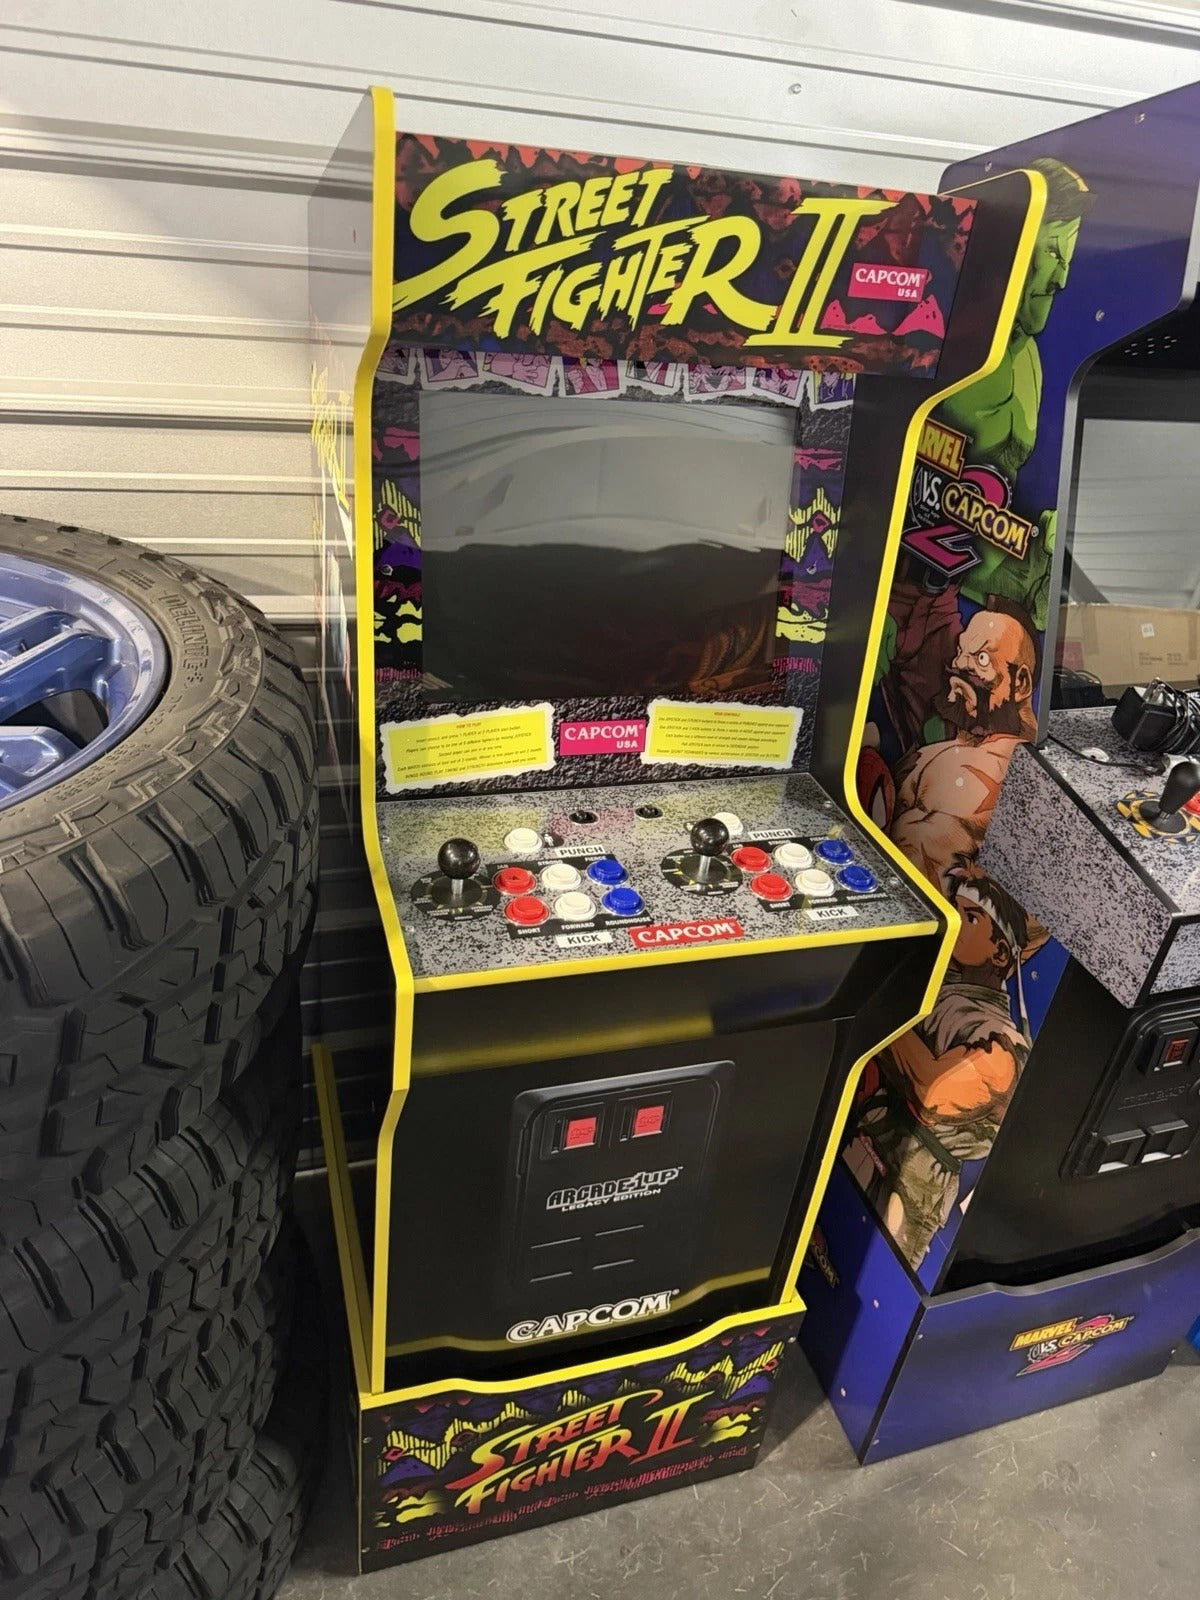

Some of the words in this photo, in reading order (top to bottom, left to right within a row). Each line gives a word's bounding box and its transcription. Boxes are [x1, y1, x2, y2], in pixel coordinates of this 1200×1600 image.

[393, 159, 674, 312] STREET
[446, 215, 778, 339] FIGHTER
[744, 197, 901, 348] II
[855, 267, 921, 288] CAPCOM
[897, 288, 918, 298] USA
[917, 422, 962, 472] RVEL
[944, 485, 1026, 552] CAPCOM
[564, 724, 639, 741] CAPCOM
[616, 740, 639, 749] USA
[752, 830, 794, 839] PUNCH
[559, 846, 604, 856] PUNCH
[605, 916, 651, 926] ROUNDHOUSE
[816, 908, 848, 918] KICK
[517, 927, 541, 935] SHORT
[561, 922, 595, 931] FORWARD
[637, 922, 736, 944] CAPCOM
[567, 933, 601, 945] KICK
[561, 1198, 610, 1212] LEGACY
[613, 1188, 662, 1202] EDITION
[506, 1290, 672, 1343] CAPCOM
[1013, 1320, 1075, 1348] MARVEL
[1061, 1320, 1125, 1346] CAPCOM
[445, 1389, 663, 1489] STREET
[454, 1425, 637, 1514] FIGHTER
[628, 1390, 717, 1466] II
